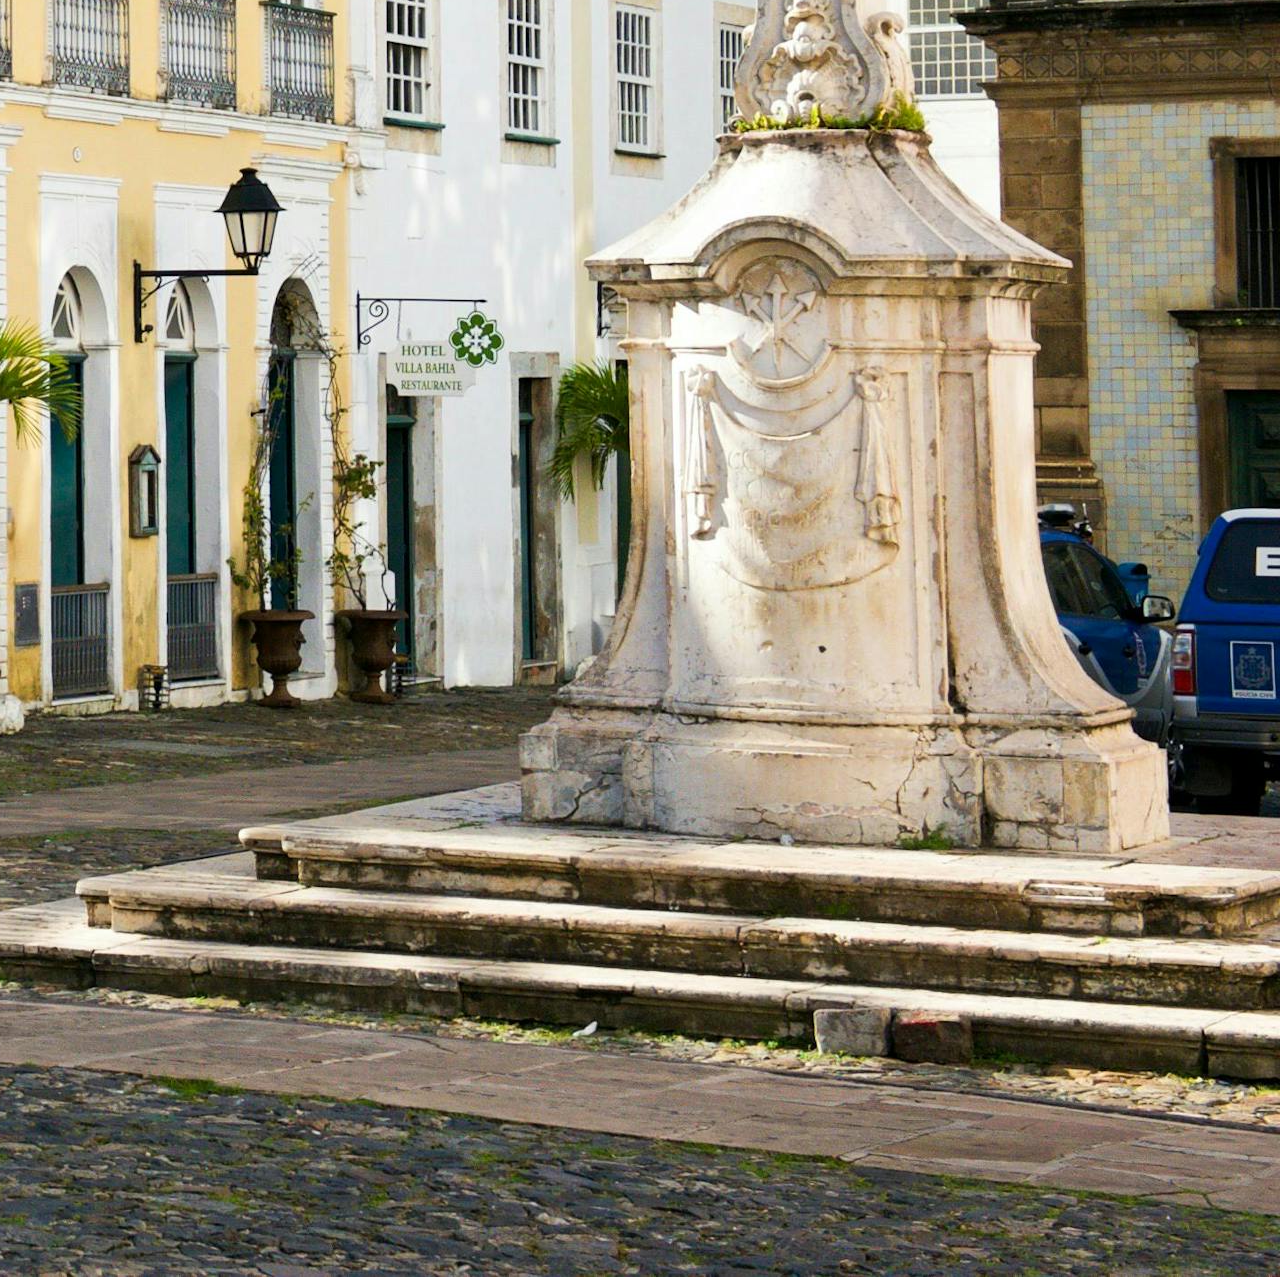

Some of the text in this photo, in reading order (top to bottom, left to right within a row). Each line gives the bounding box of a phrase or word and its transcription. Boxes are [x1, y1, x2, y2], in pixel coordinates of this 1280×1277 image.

[401, 345, 446, 357] HOTEL
[394, 362, 456, 374] VILLA BAHIA
[400, 379, 463, 392] RESTAURANTE
